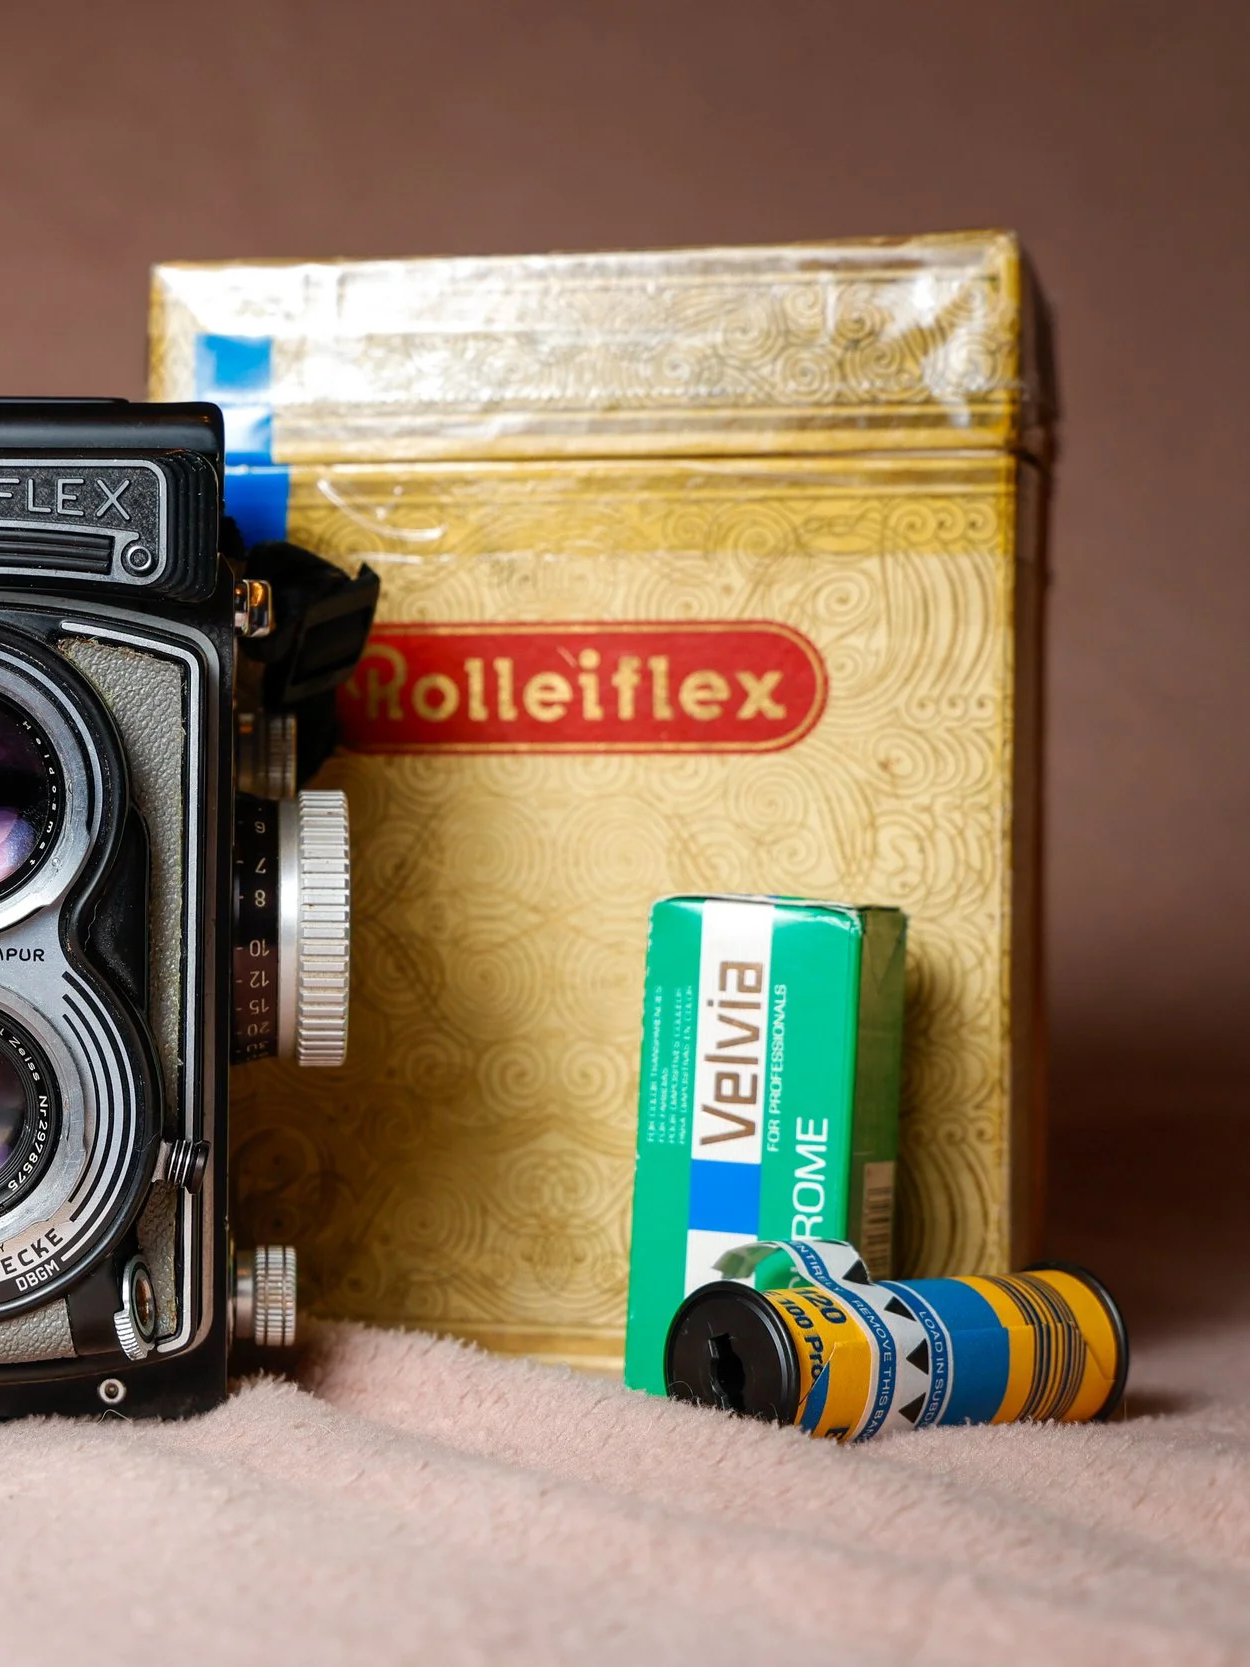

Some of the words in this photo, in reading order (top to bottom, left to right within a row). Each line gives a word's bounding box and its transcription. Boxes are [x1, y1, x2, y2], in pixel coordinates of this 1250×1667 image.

[347, 643, 786, 723] Rolleiflex
[254, 857, 267, 874] 7
[254, 889, 267, 908] 8
[249, 938, 270, 957] 10
[249, 970, 270, 988] 12
[249, 998, 270, 1015] 15
[247, 1021, 270, 1037] 20
[8, 1036, 40, 1082] Zeiss
[700, 960, 764, 1146] Velvia
[770, 983, 787, 1113] PROFESSIONALS
[767, 1119, 780, 1152] FOR
[789, 1116, 828, 1294] ROME
[15, 1259, 61, 1292] DBGM
[779, 1299, 814, 1329] 100
[796, 1288, 847, 1325] 120
[851, 1299, 892, 1363] REMOVE
[919, 1311, 943, 1351] LOAD
[935, 1357, 944, 1374] IN
[878, 1366, 892, 1406] THIS
[861, 1409, 884, 1440] BAN
